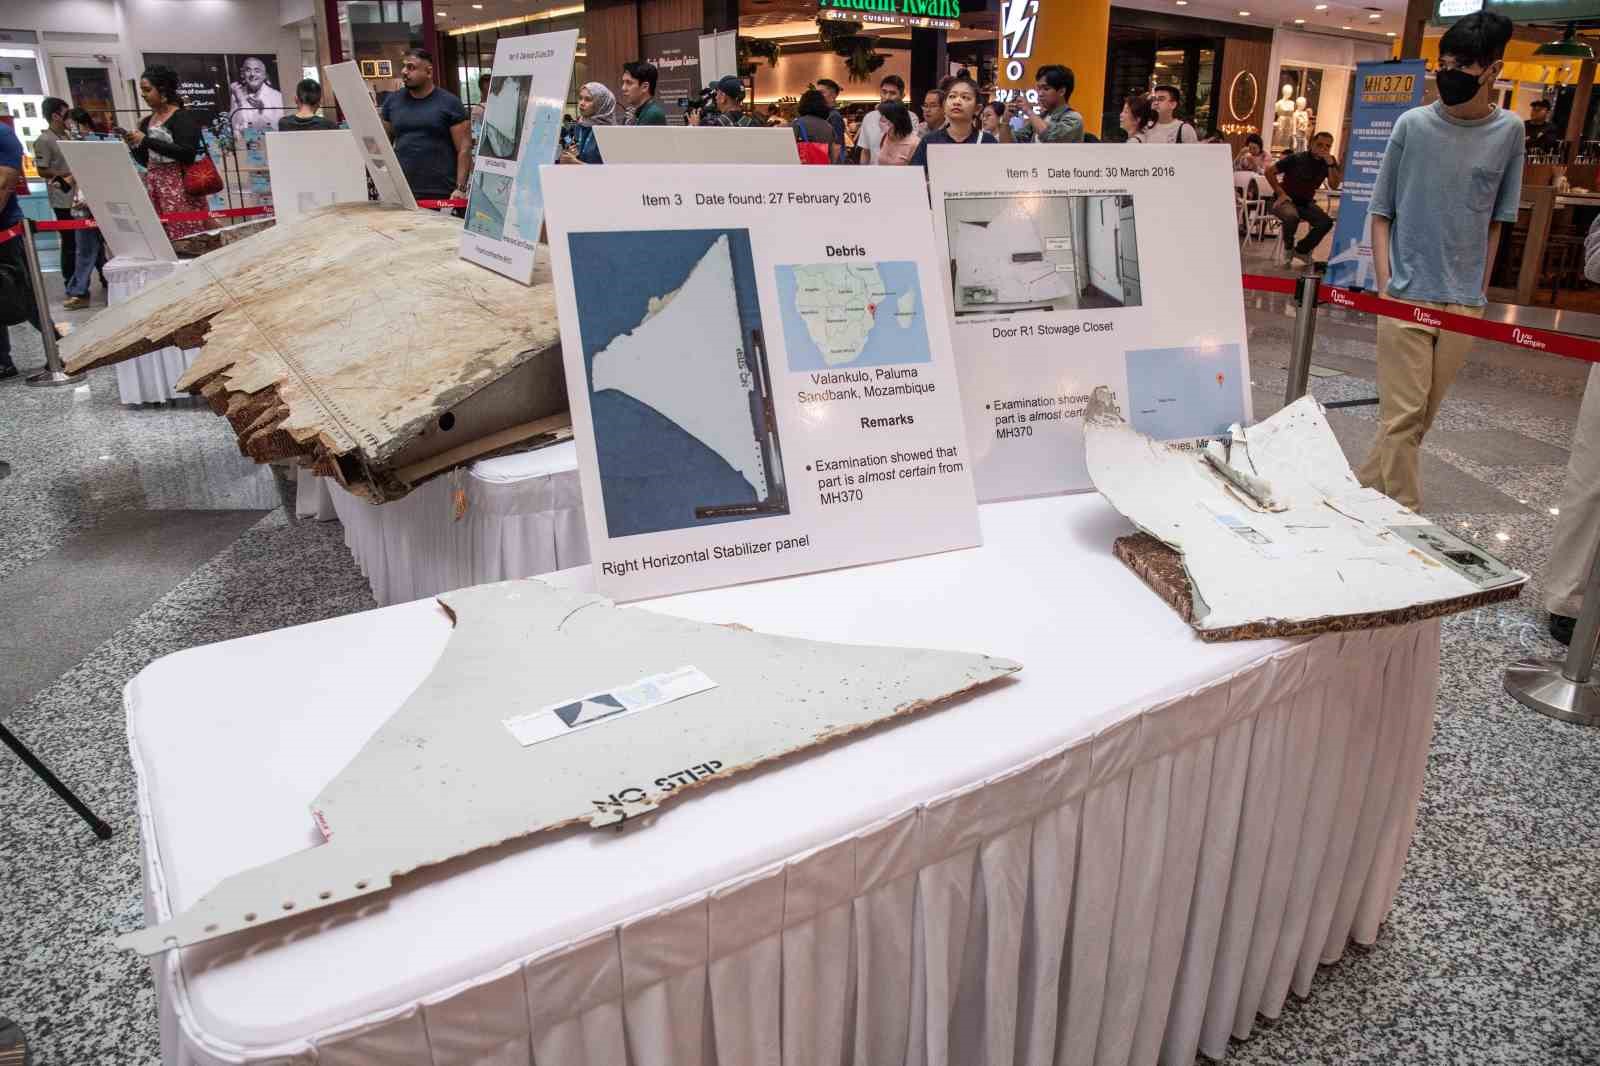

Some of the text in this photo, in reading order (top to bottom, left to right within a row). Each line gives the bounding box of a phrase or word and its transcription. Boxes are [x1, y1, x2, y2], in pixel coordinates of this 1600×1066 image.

[863, 15, 896, 23] CUISINE
[1007, 165, 1175, 178] Item 5 Date found: 30 March 2016
[641, 191, 872, 207] Item 3 Date found: 27 February 2016
[825, 244, 867, 257] Debris
[992, 321, 1114, 338] Door R1 Stowage Closet
[811, 367, 918, 386] Valankulo, Paluma
[798, 382, 936, 404] Sandbank, Mozambique
[993, 392, 1089, 411] Examination showe
[860, 413, 914, 429] Remarks
[995, 414, 1015, 427] part
[1018, 413, 1026, 424] is
[1029, 409, 1062, 421] almost
[996, 425, 1033, 440] MH370
[815, 445, 958, 473] Examination showed that
[818, 461, 964, 491] part is almost certain from
[820, 488, 864, 506] MH370
[602, 533, 810, 577] Right Horizontal Stabilizer panel
[654, 759, 723, 792] STEP
